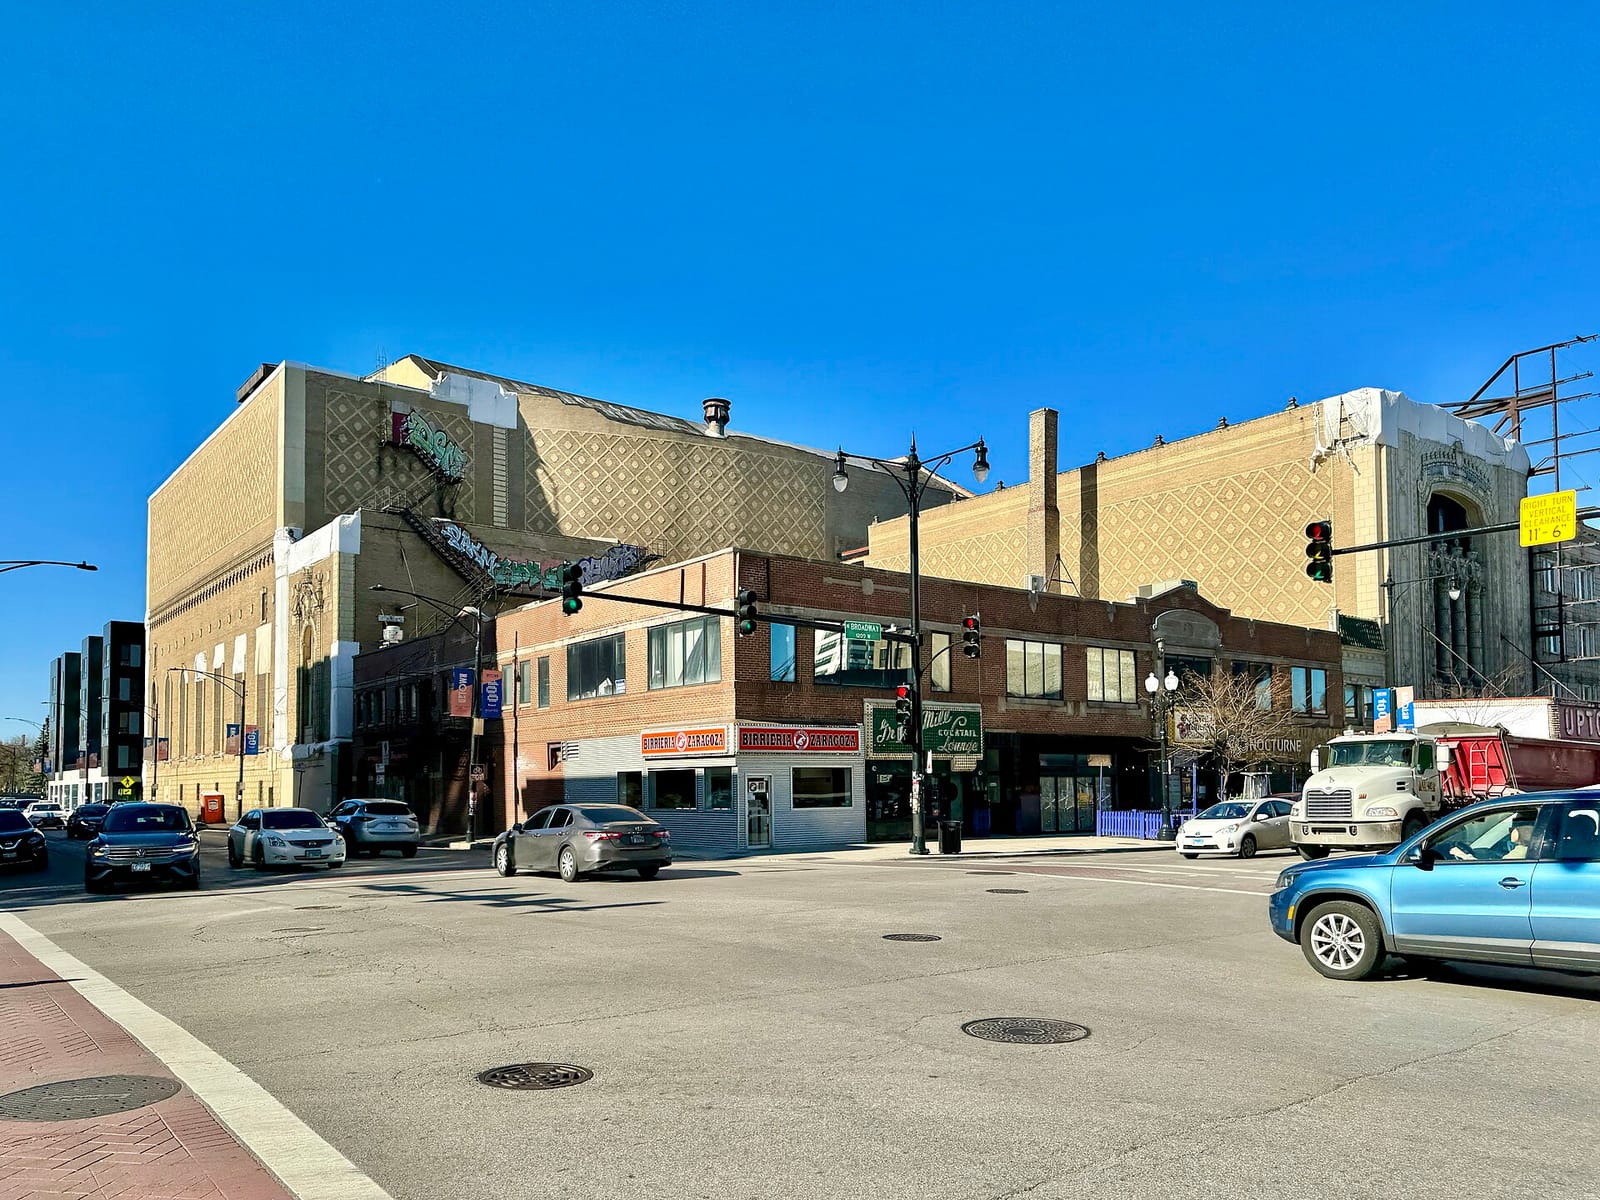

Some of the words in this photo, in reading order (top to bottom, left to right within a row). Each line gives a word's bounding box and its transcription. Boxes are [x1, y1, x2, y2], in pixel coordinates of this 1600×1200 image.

[1524, 499, 1546, 510] RIGHT
[1553, 495, 1572, 505] TURN
[1529, 506, 1566, 518] VERTICAL
[1524, 513, 1571, 528] CLEARANCE
[850, 623, 879, 632] BROADWAY
[458, 673, 467, 703] UPTOWN
[922, 710, 953, 729] Mill
[741, 733, 792, 746] BIRRIERIA
[809, 734, 857, 747] ZARAGOZA
[938, 729, 978, 738] COCKTAIL
[643, 737, 675, 749] BIRRIERIA
[687, 733, 725, 747] ZARAGOZA
[1249, 739, 1302, 753] NOCTURNE
